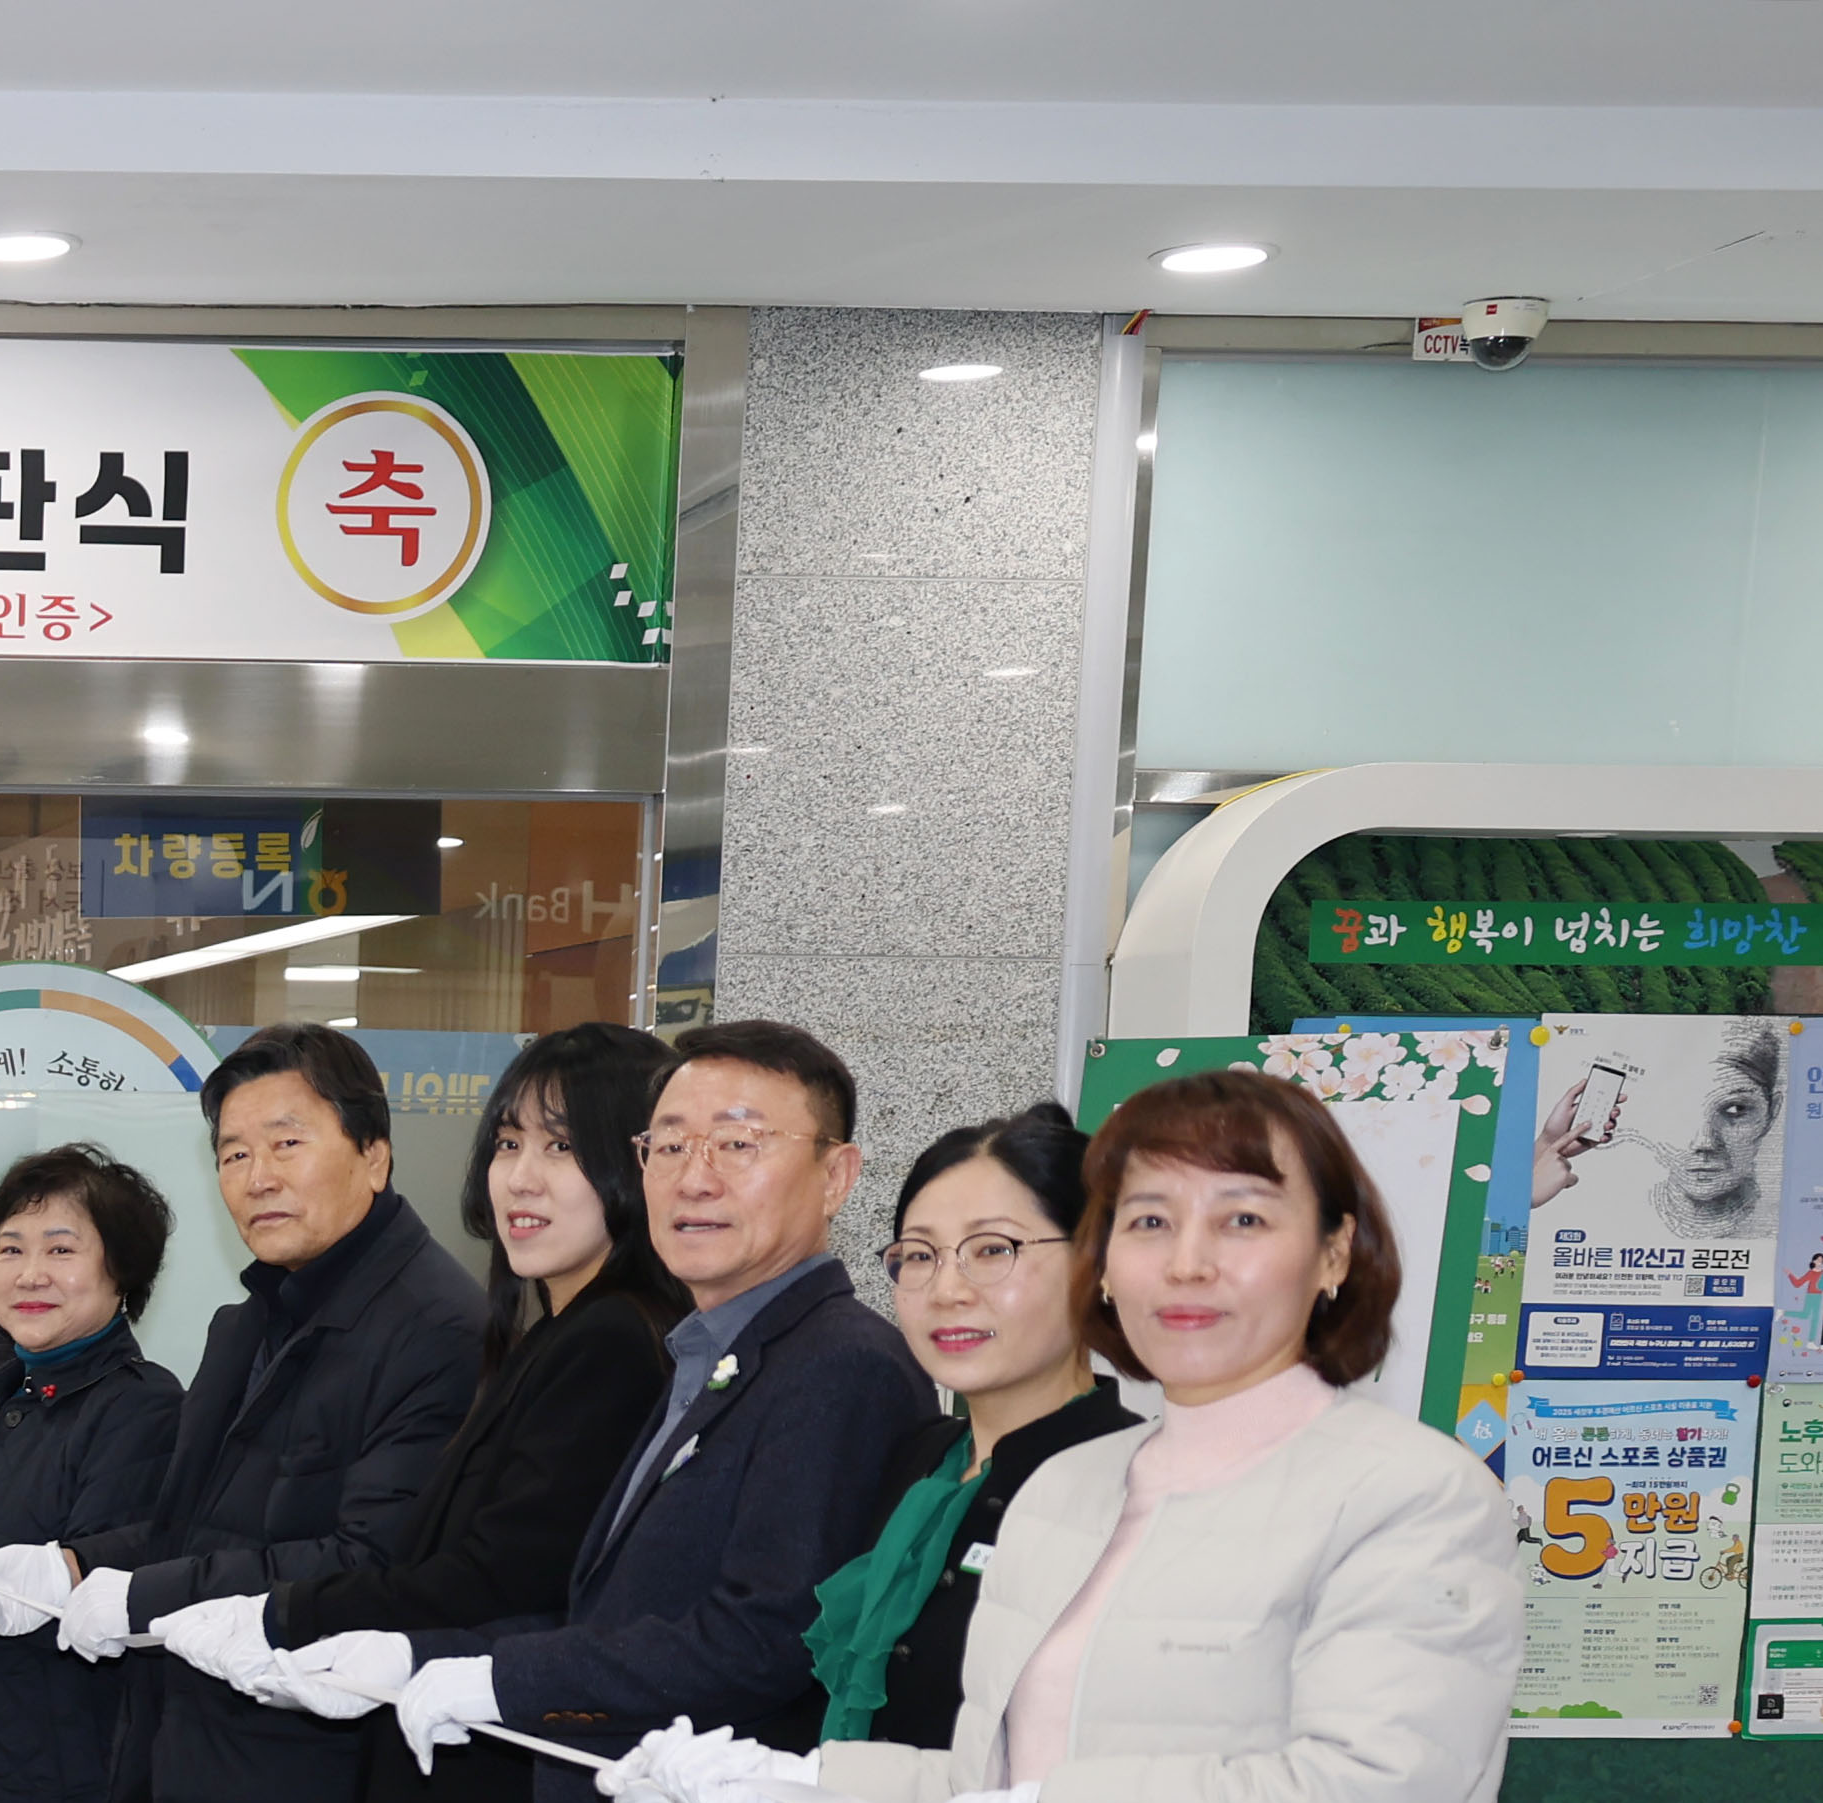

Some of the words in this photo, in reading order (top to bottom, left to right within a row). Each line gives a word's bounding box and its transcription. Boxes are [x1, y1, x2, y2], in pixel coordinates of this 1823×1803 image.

[324, 449, 438, 567] 축
[114, 832, 293, 878] 차량등록
[1331, 908, 1407, 953] 꿈과
[1426, 906, 1534, 954] 행복이
[1555, 908, 1664, 953] 넘치는
[1684, 907, 1808, 955] 희망찬
[1552, 1247, 1614, 1268] 올바른
[1620, 1248, 1685, 1269] 112신고
[1691, 1249, 1751, 1270] 공모전
[1532, 1447, 1593, 1468] 어르신
[1599, 1447, 1660, 1468] 스포츠
[1667, 1447, 1728, 1468] 상품권
[1540, 1476, 1615, 1580] 5
[1621, 1491, 1700, 1534] 만원
[1618, 1537, 1700, 1580] 지급
